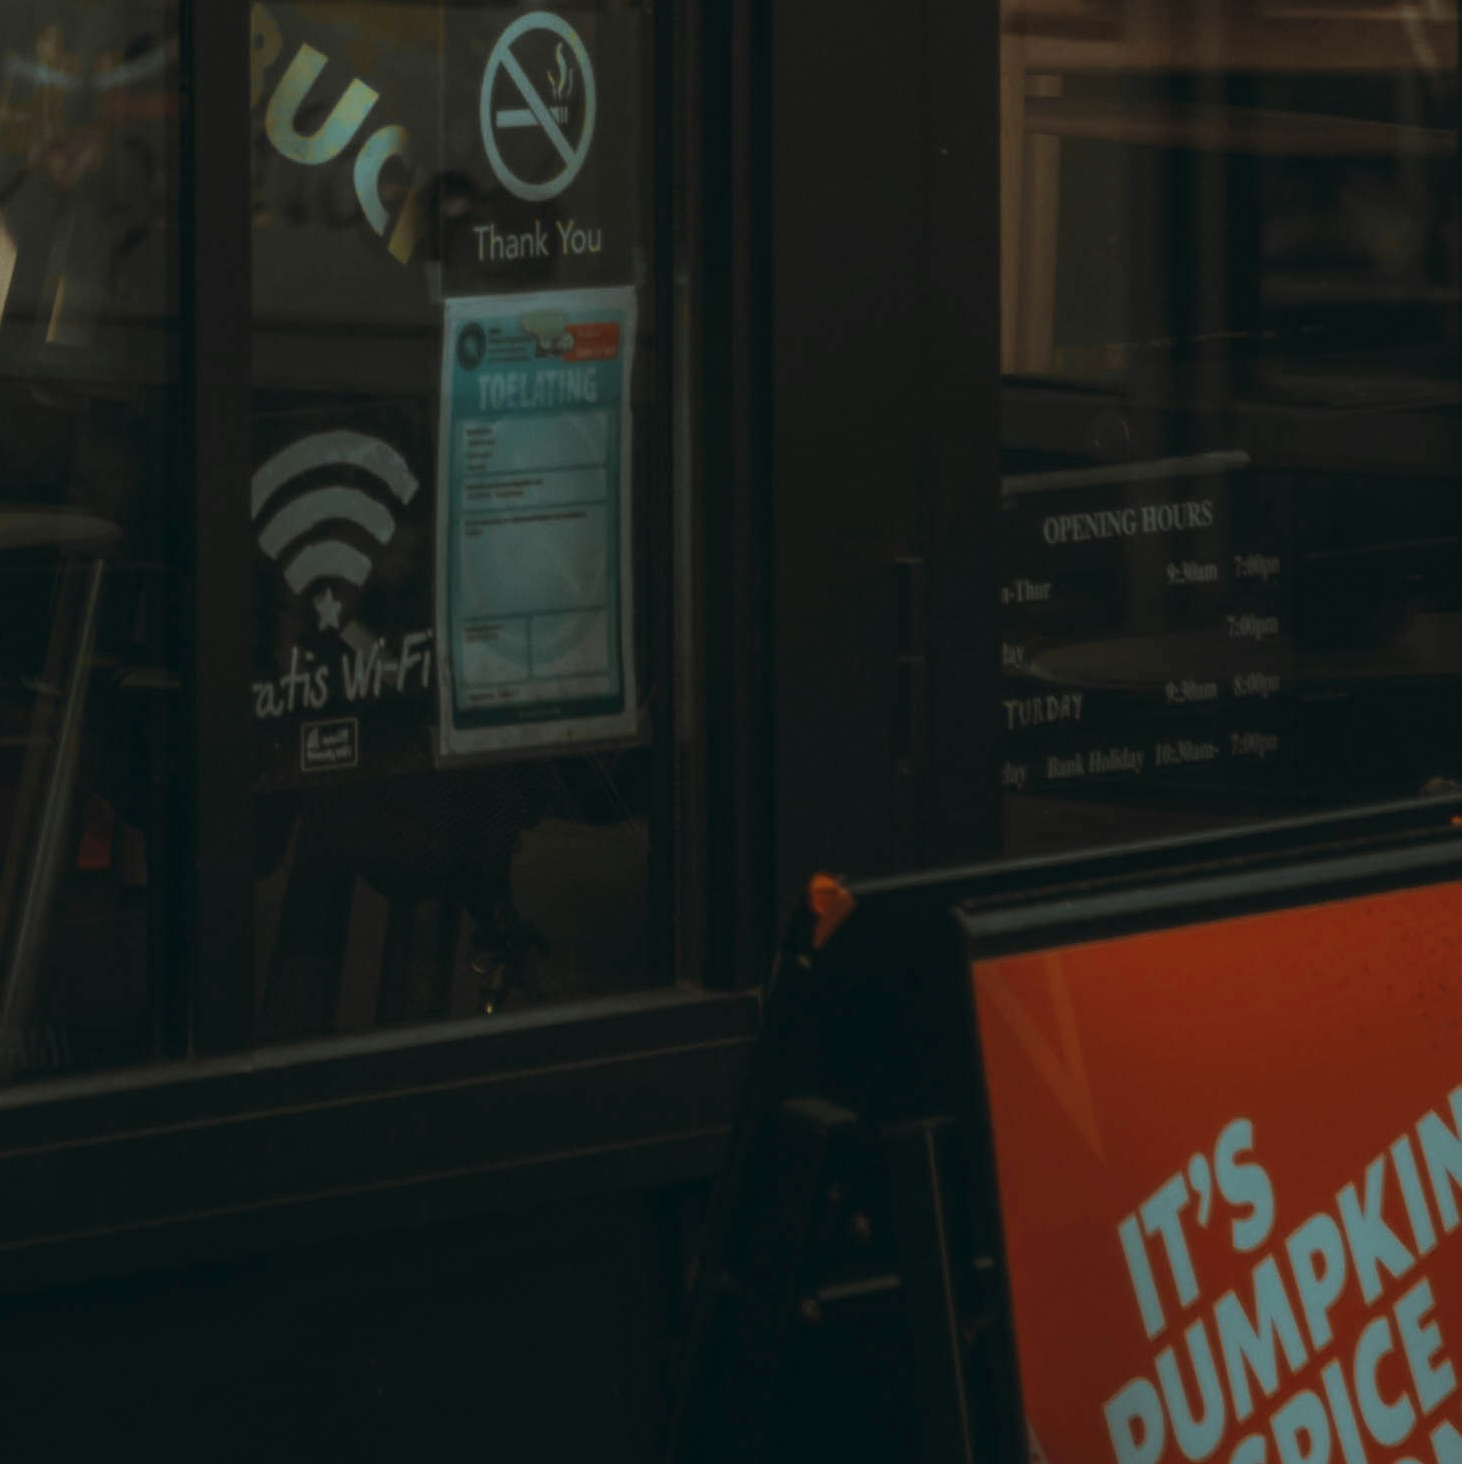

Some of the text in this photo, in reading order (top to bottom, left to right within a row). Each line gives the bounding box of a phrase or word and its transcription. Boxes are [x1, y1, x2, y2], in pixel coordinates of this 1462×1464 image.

[471, 219, 602, 262] Thank You
[477, 365, 599, 411] TOELATING
[1042, 499, 1214, 545] OPENING HOURS
[251, 626, 434, 719] atis Wi-Fi
[1045, 752, 1086, 781] Bank
[1088, 745, 1147, 775] Holiday
[1116, 1115, 1276, 1341] IT'S
[1228, 1276, 1459, 1464] PICE
